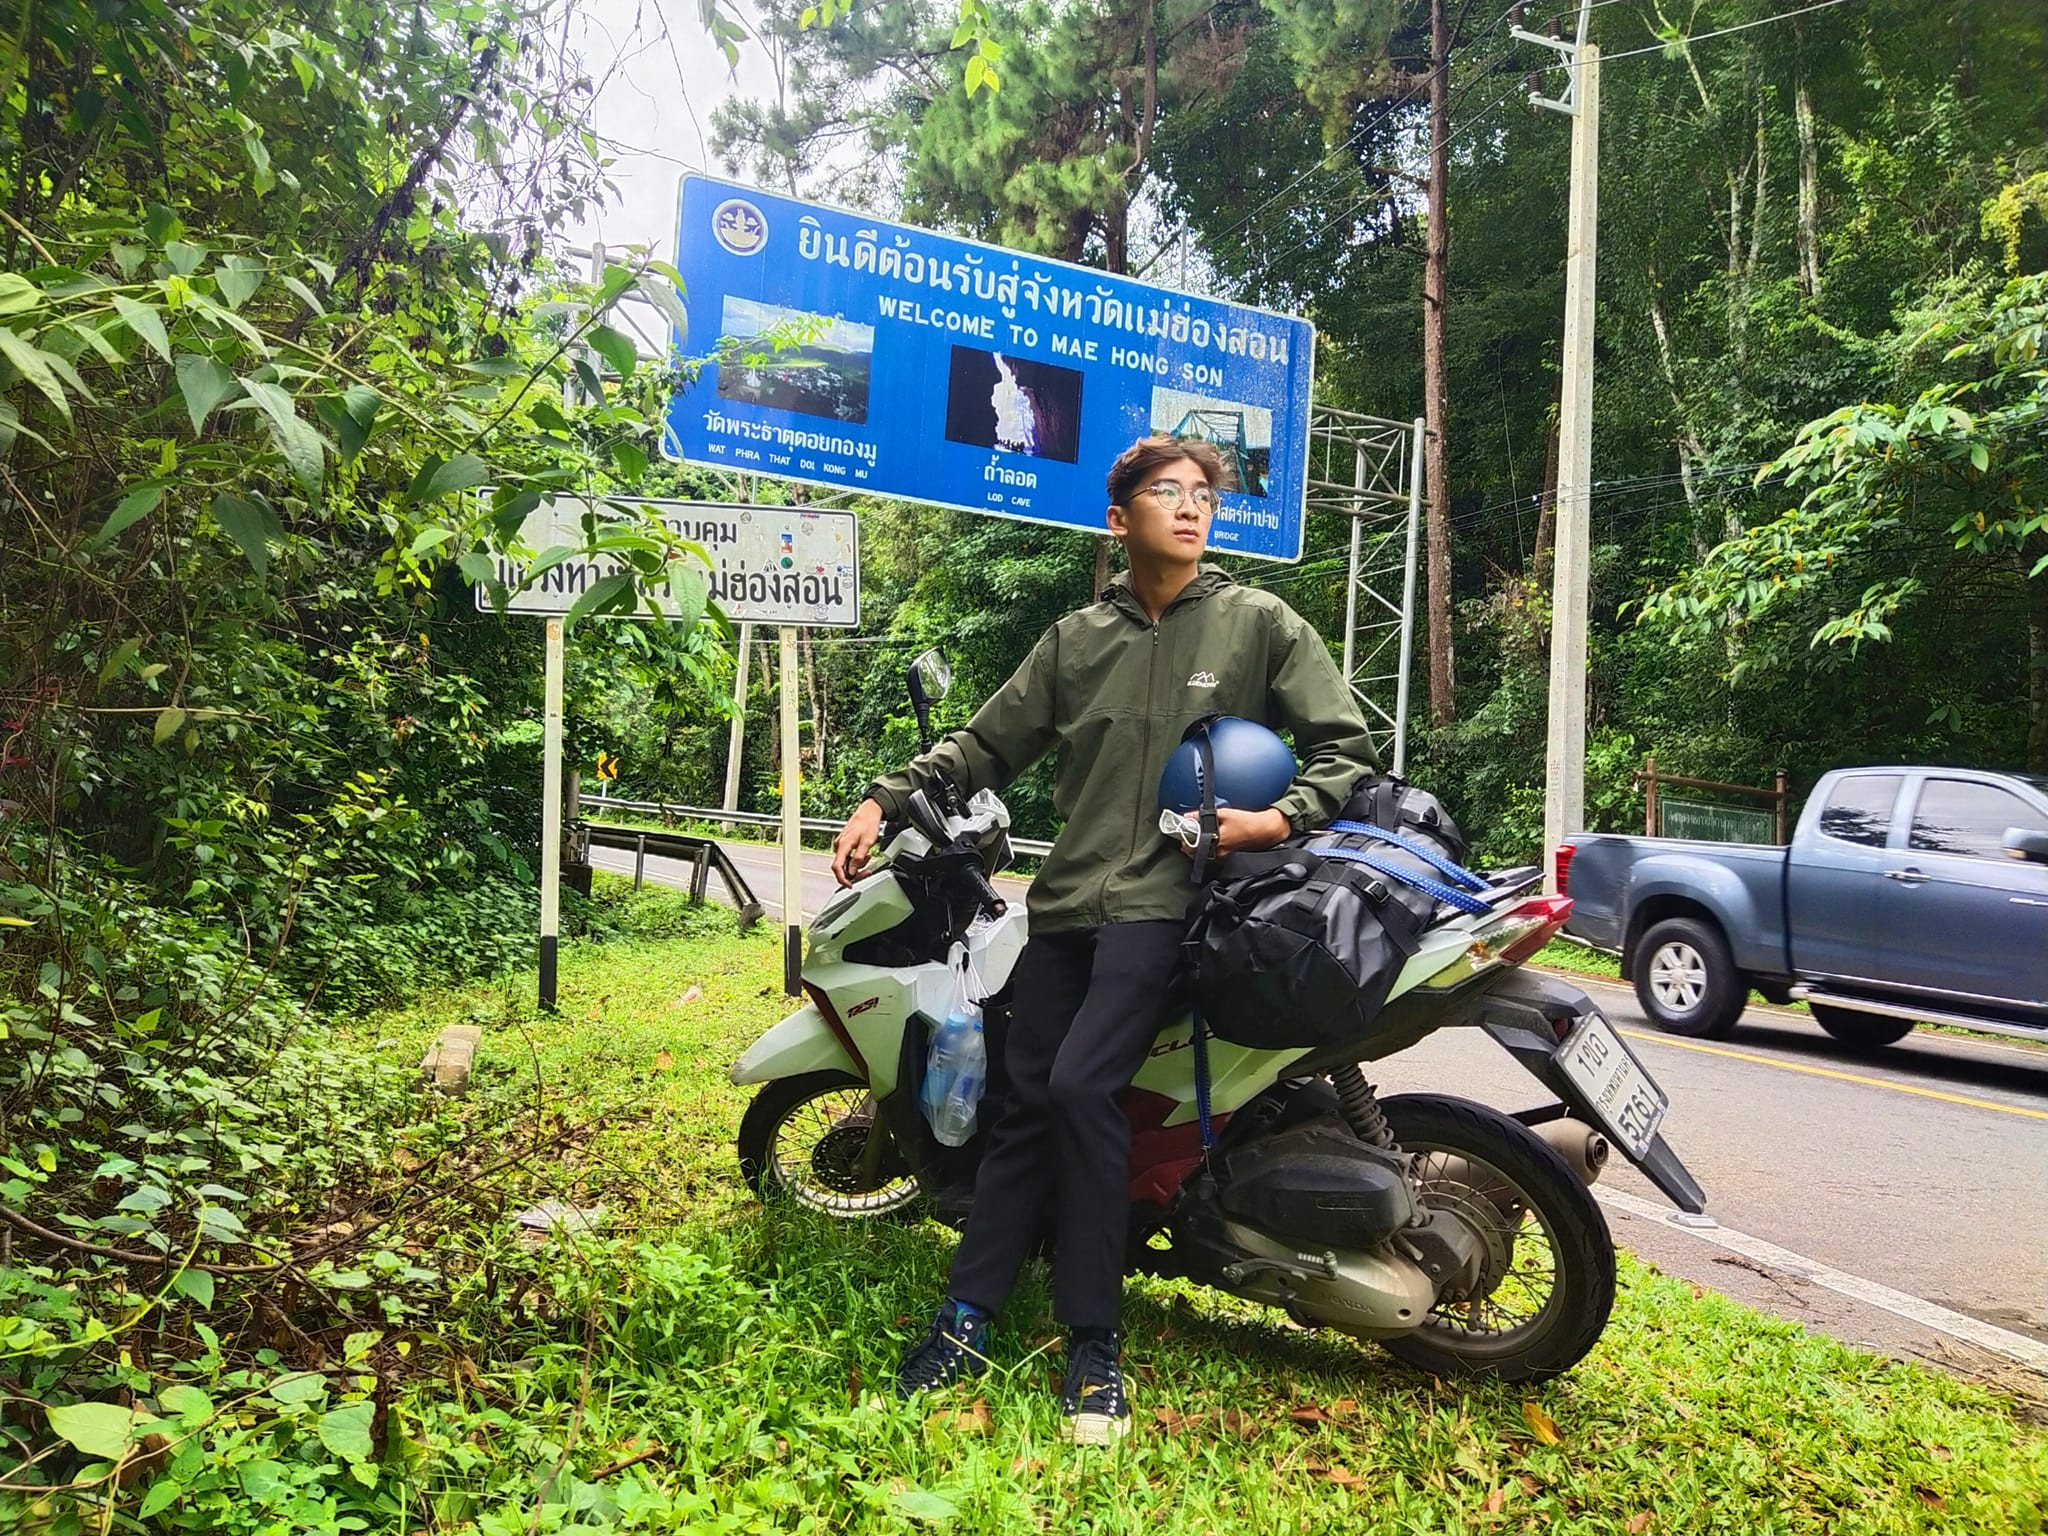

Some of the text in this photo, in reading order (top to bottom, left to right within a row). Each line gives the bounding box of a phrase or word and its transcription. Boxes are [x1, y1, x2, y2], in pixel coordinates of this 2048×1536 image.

[797, 215, 1290, 366] ยินดีต้อนรับสู่จังหวัดแม่ฮ่องสอน
[878, 295, 1223, 388] WELCOME TO MAE HONG SON
[702, 409, 878, 467] วัดพระธาตุดอยกองมู
[708, 443, 868, 479] WAT PHRA THAT DOI KONG MU
[984, 454, 1037, 489] ถ้ำลอด
[987, 492, 1031, 507] LOD CAVE
[1214, 530, 1239, 542] BRIDGE
[1617, 1083, 1659, 1142] 5761
